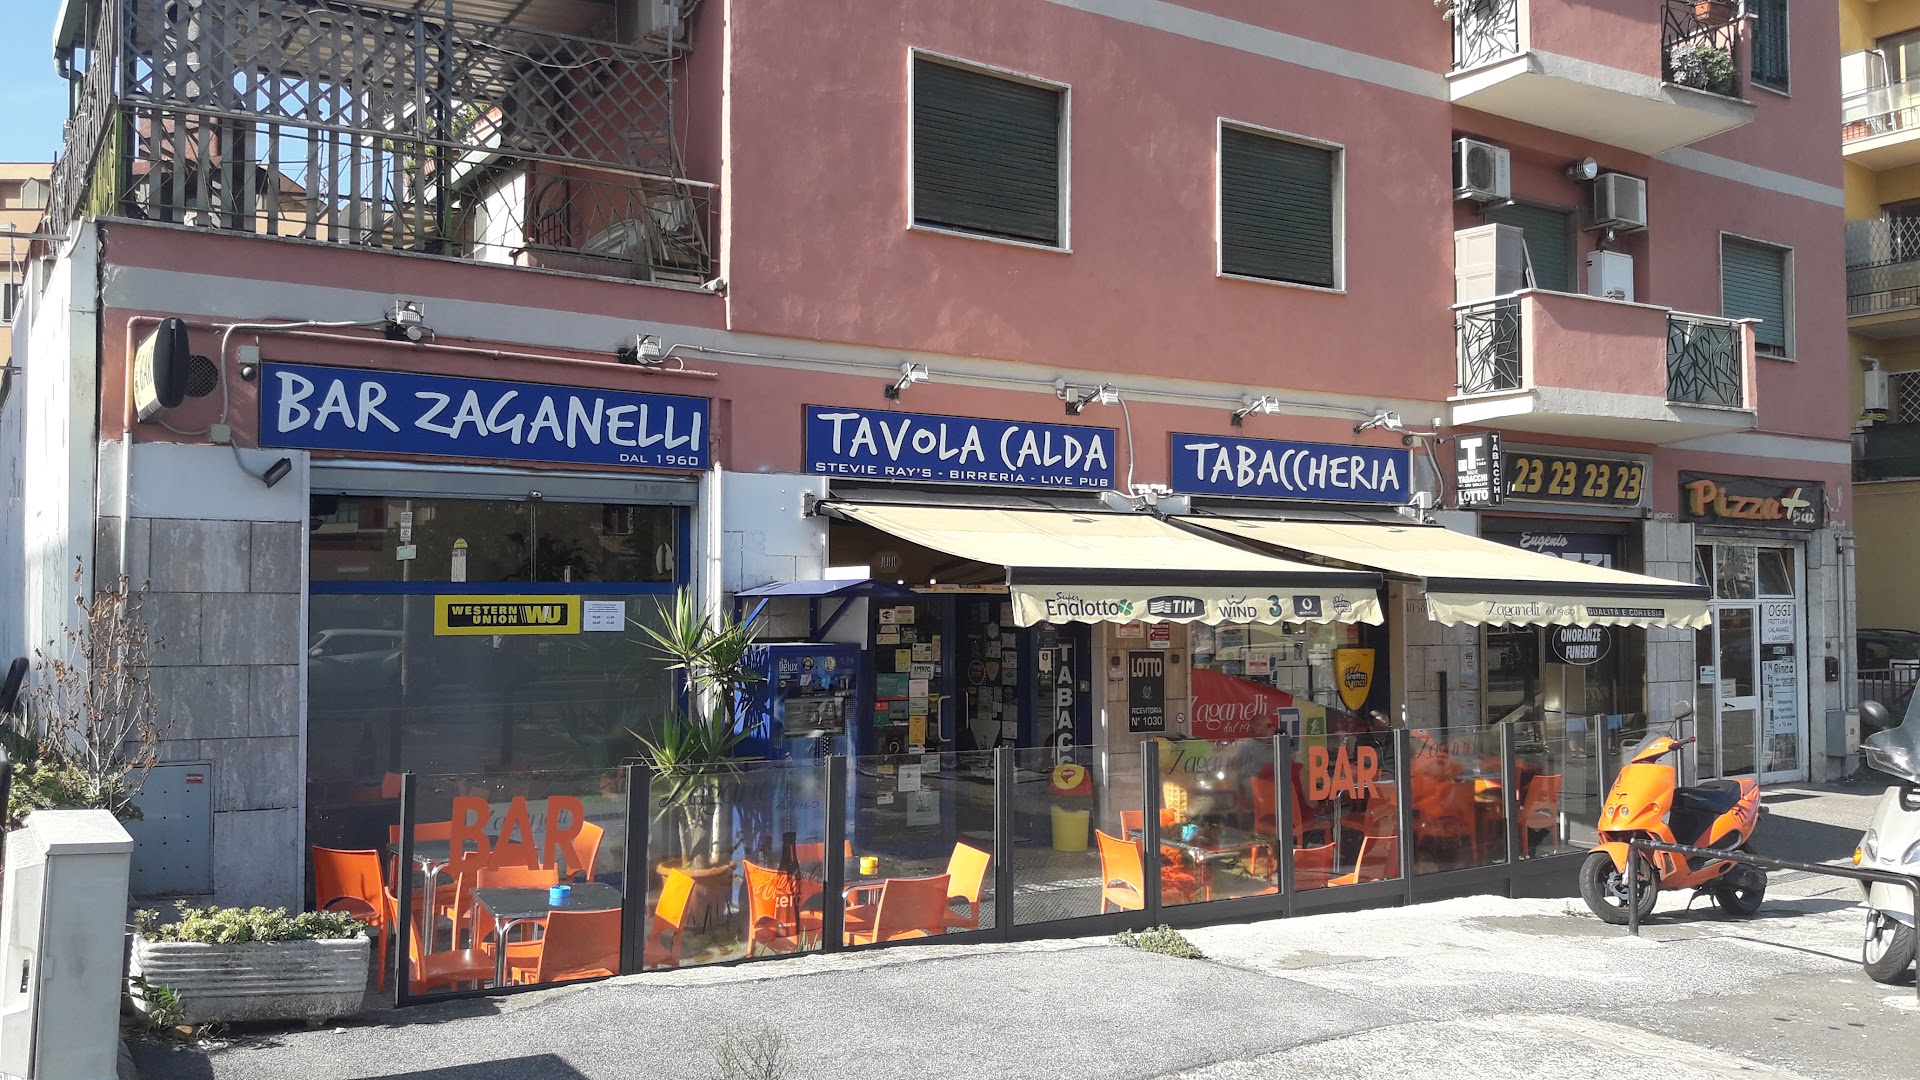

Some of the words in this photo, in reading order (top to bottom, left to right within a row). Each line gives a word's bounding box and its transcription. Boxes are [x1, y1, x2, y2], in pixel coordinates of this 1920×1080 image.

[275, 371, 400, 433] BAR
[414, 389, 701, 451] ZAGANELLI
[817, 413, 985, 464] TAVOLA
[1000, 426, 1107, 471] CALDA
[620, 453, 648, 464] DAL
[656, 454, 699, 466] 1960
[1184, 443, 1400, 492] TABACCHERIA
[1491, 435, 1501, 502] TABACCHI
[815, 463, 877, 475] STEVIE
[885, 466, 932, 478] RAY'S
[949, 470, 1025, 482] BIRRERIA
[1041, 475, 1073, 485] LIVE
[1079, 477, 1109, 487] PUB
[1458, 473, 1488, 484] TABACCHI
[1512, 457, 1544, 493] 23
[1548, 461, 1577, 495] 23
[1582, 463, 1610, 497] 23
[1614, 466, 1641, 499] 23
[1458, 489, 1488, 502] LOTTO
[1520, 532, 1568, 552] Eugenio
[1056, 591, 1079, 602] Super
[452, 605, 518, 615] WESTERN
[1045, 599, 1120, 616] Enalotto
[1172, 600, 1196, 614] TIM
[1218, 606, 1257, 618] WIND
[1267, 595, 1283, 618] 3
[1485, 601, 1540, 620] Zaganelli
[1622, 608, 1627, 616] E
[1629, 609, 1663, 617] CORTESIA
[1768, 604, 1791, 617] OGGI
[472, 614, 518, 624] UNION
[1561, 628, 1601, 643] ONORANZE
[1565, 645, 1597, 659] FUNEBRI
[1131, 657, 1162, 678] LOTTO
[1056, 643, 1073, 767] TABACC
[1131, 707, 1162, 715] RICEVITORIA
[1143, 716, 1162, 726] 1030
[1309, 745, 1380, 801] BAR
[449, 795, 584, 872] BAR
